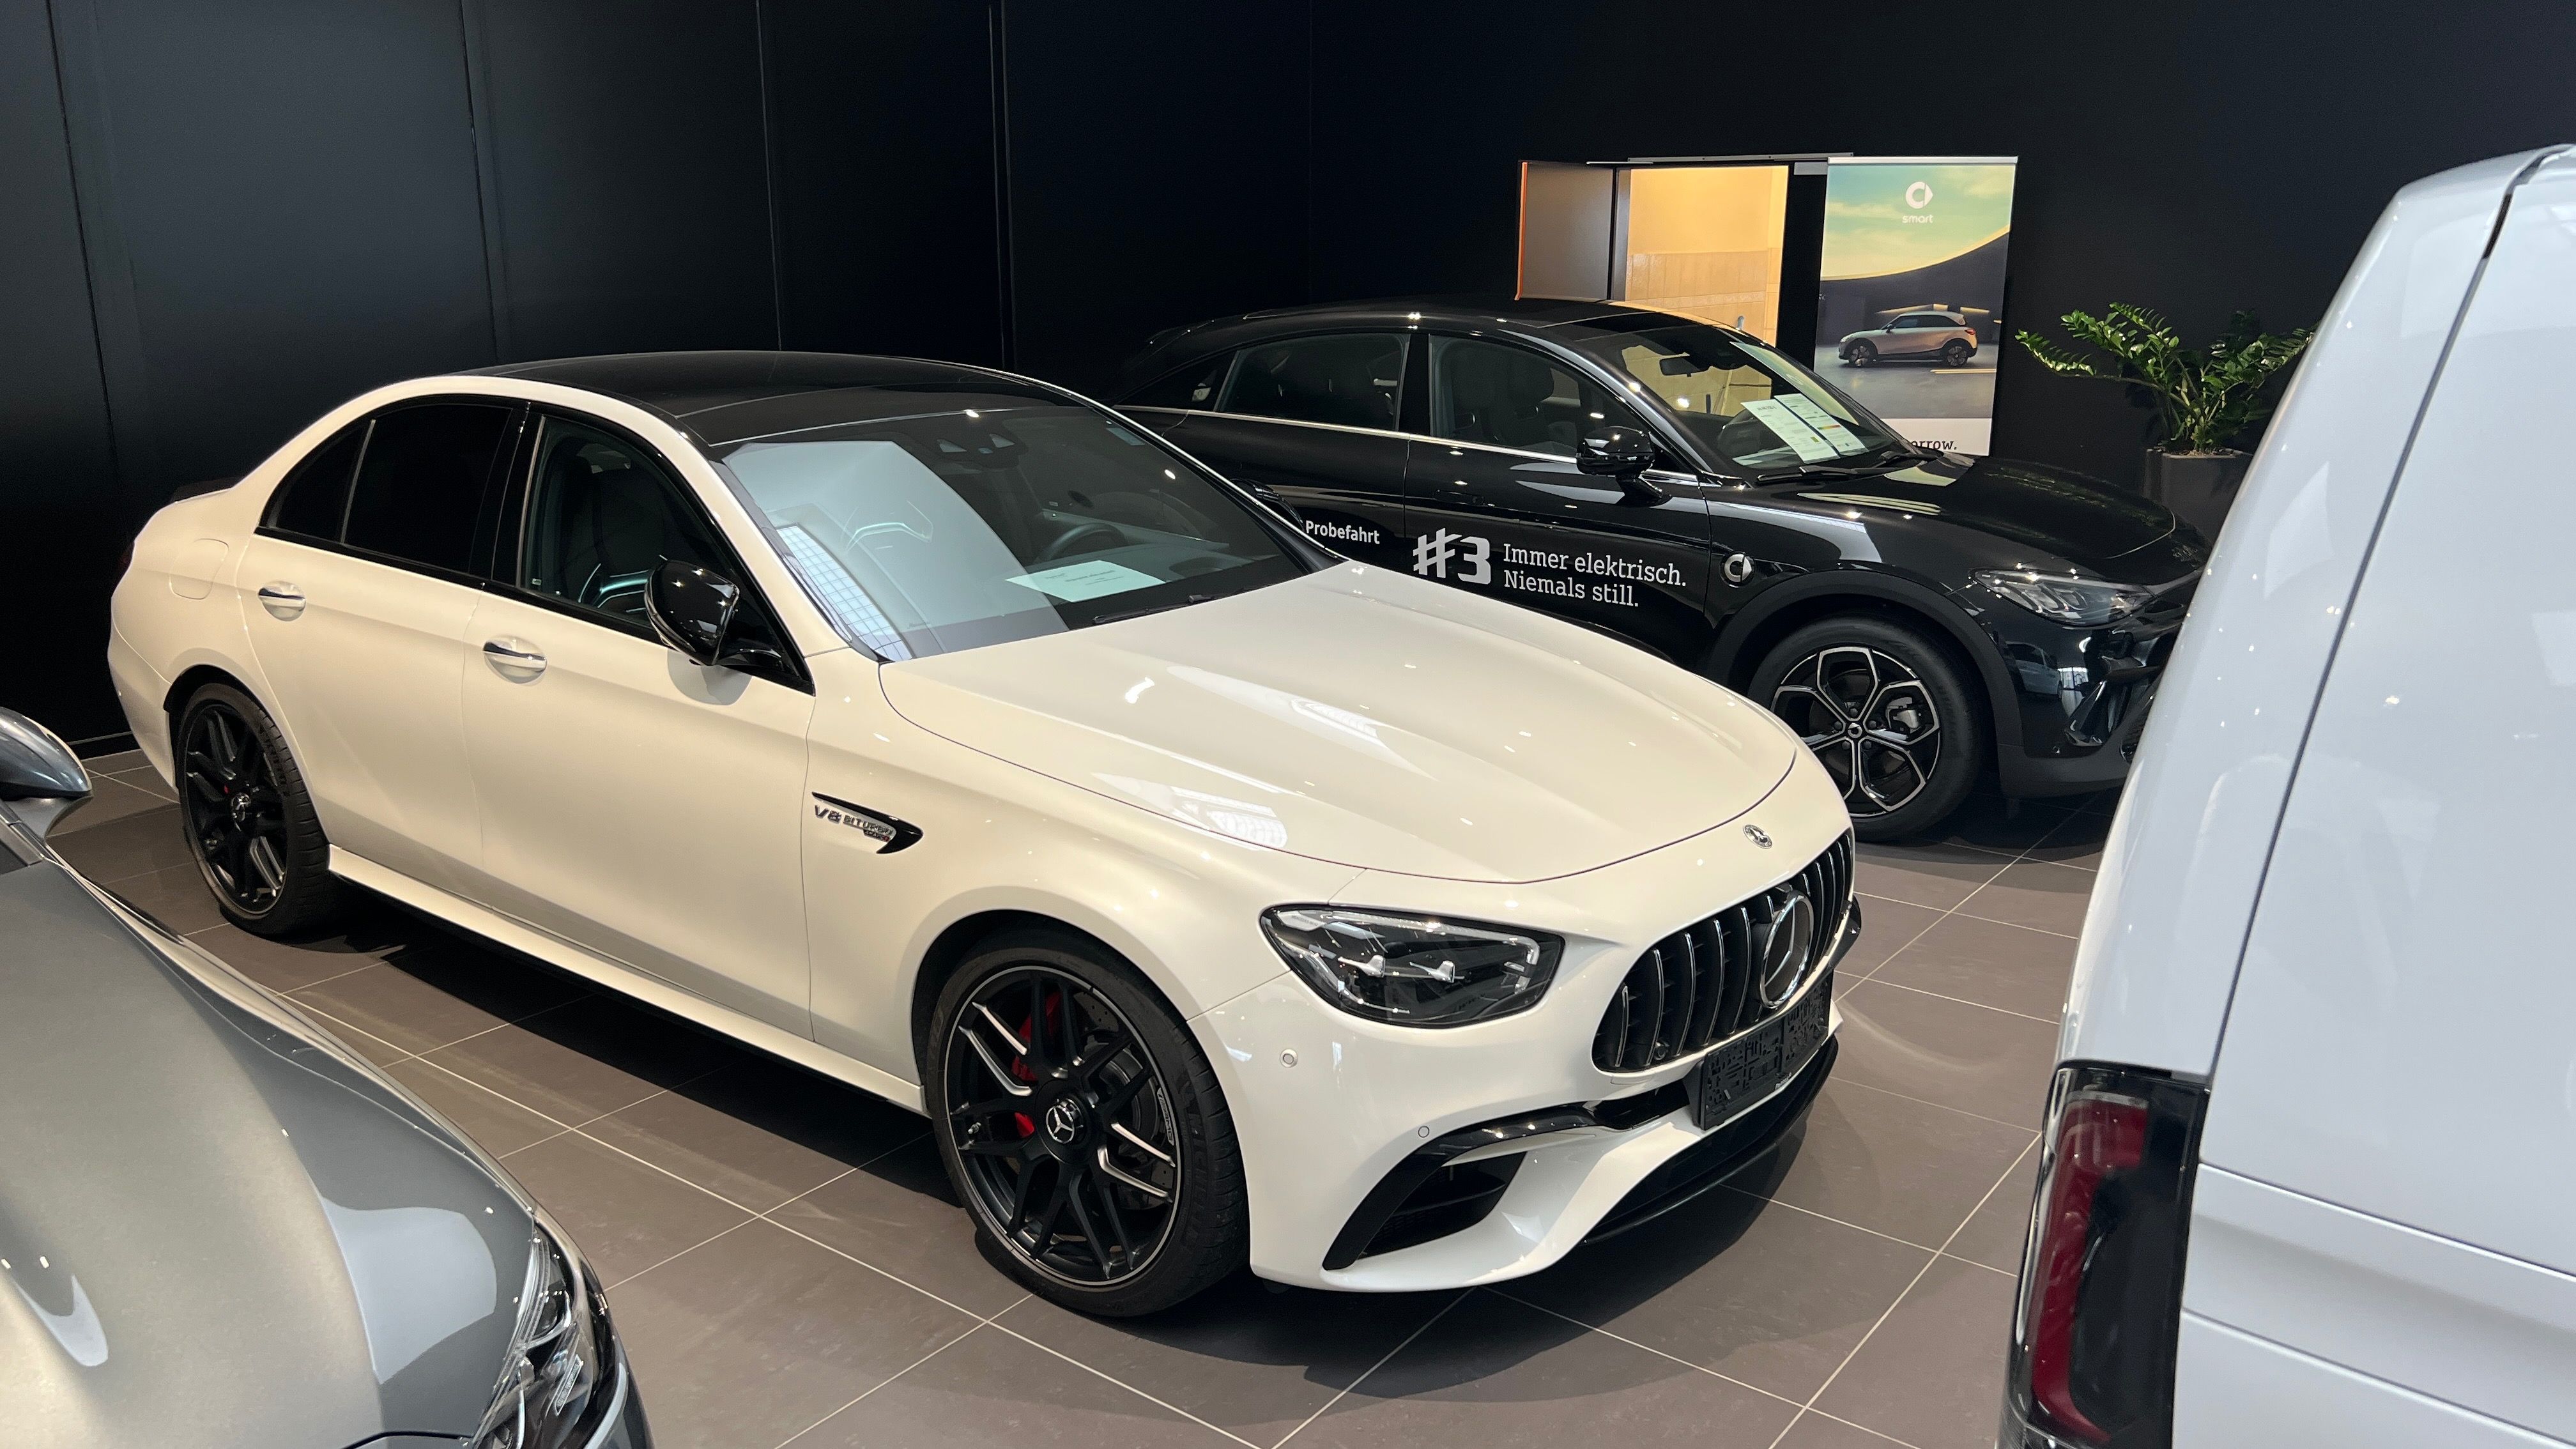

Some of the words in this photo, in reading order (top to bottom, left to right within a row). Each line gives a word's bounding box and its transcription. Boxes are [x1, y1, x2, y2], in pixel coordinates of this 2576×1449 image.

[1901, 214, 1933, 223] smart
[1305, 520, 1380, 544] Probefahrt
[1413, 528, 1491, 585] #3
[1503, 543, 1568, 570] Immer
[1574, 553, 1687, 586] elektrisch.
[1504, 569, 1585, 599] Niemals
[1592, 584, 1639, 607] still.
[815, 805, 841, 824] V8
[843, 815, 893, 836] BITURBO
